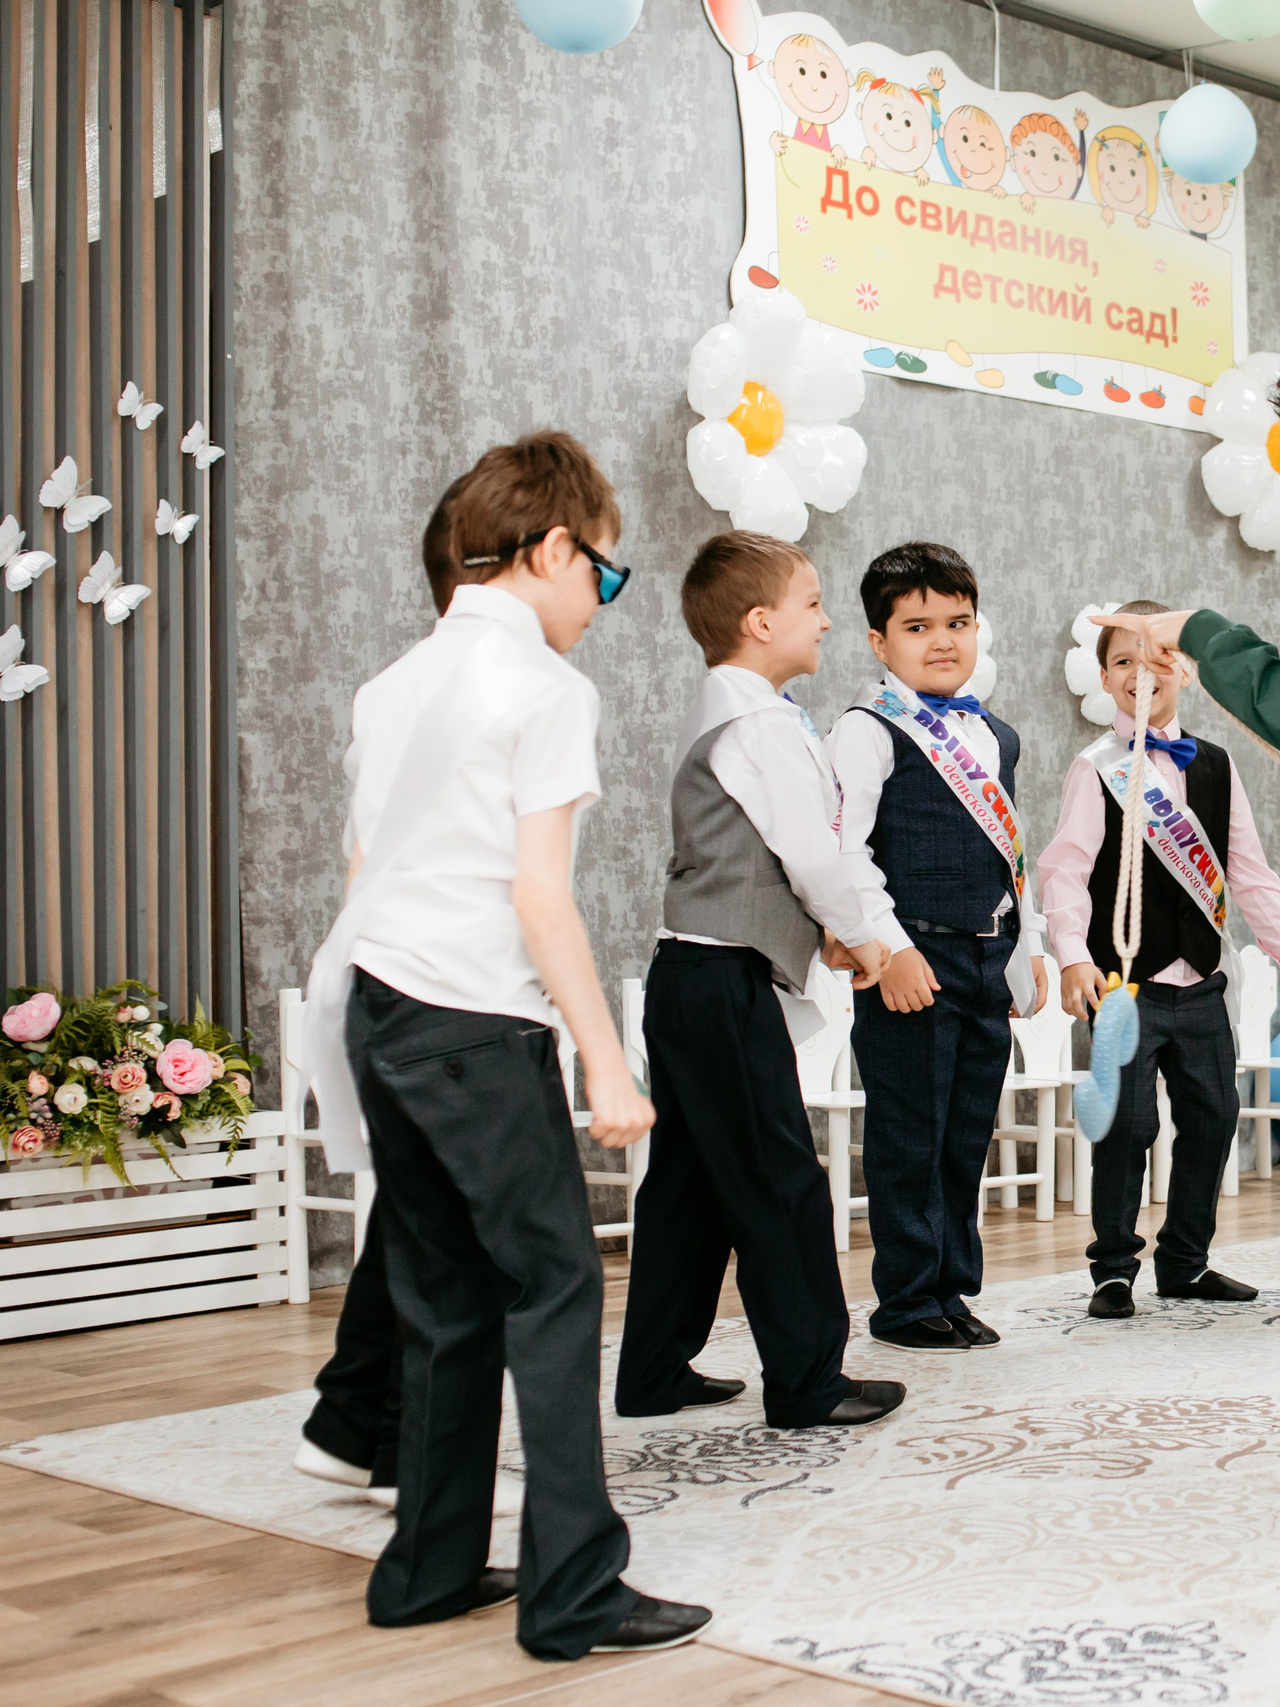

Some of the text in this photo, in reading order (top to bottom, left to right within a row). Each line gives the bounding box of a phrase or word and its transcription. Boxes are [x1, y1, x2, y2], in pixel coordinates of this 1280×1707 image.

[820, 165, 1100, 278] До свидания,
[933, 262, 1179, 349] детский сад!
[943, 762, 998, 832] детского
[1157, 835, 1201, 889] детского
